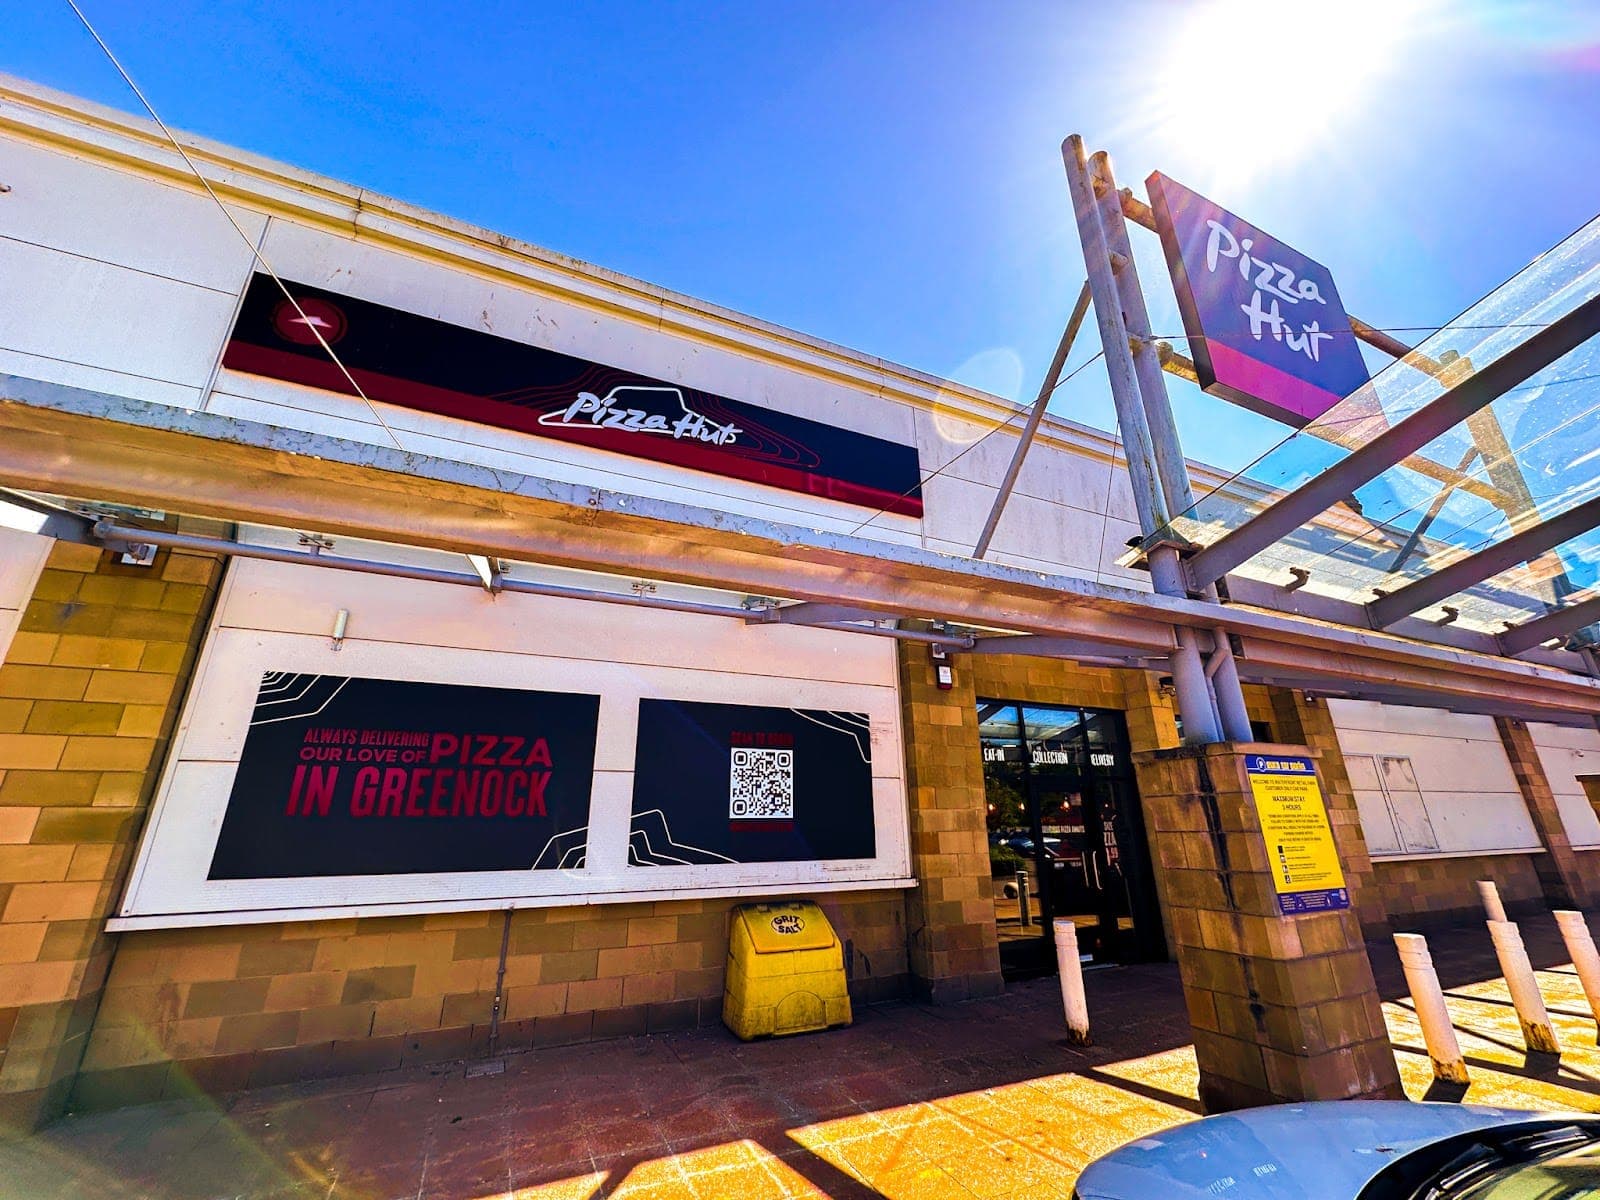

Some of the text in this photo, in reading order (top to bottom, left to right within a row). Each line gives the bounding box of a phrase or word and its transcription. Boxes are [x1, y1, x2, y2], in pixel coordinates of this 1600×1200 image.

[1206, 219, 1327, 305] Pizza
[1240, 289, 1334, 363] Hut
[562, 391, 743, 446] Pizza Hut
[299, 746, 427, 763] OUR LOVE OF
[304, 728, 553, 767] ALWAYS DELIVERING PIZZA
[983, 747, 1005, 762] EAT-IN
[1032, 750, 1069, 765] COLLECTION
[284, 765, 553, 817] IN GREENOCK
[774, 915, 801, 925] GRIT
[778, 923, 802, 934] SALT
